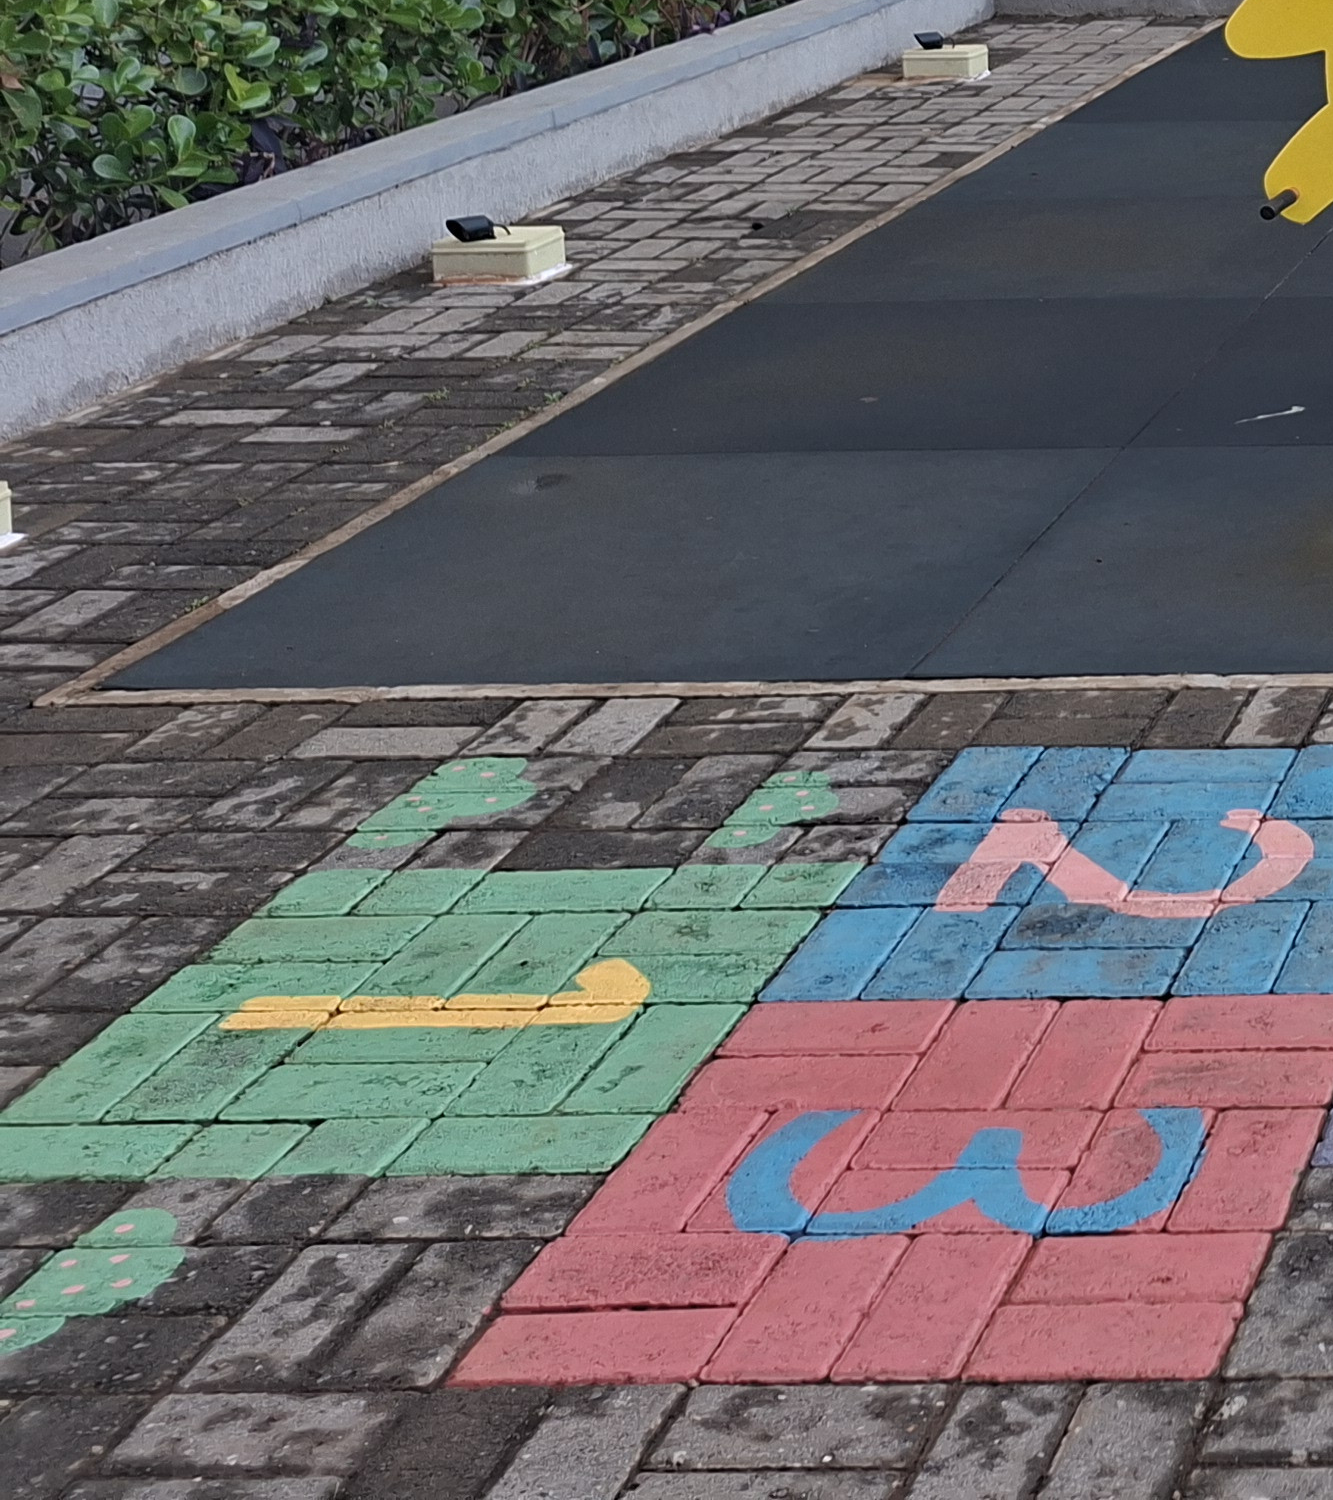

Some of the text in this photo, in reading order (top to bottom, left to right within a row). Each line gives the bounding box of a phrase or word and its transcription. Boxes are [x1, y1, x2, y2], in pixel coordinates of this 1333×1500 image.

[935, 807, 1316, 918] 2
[219, 957, 653, 1031] 1
[725, 1104, 1214, 1242] 3
